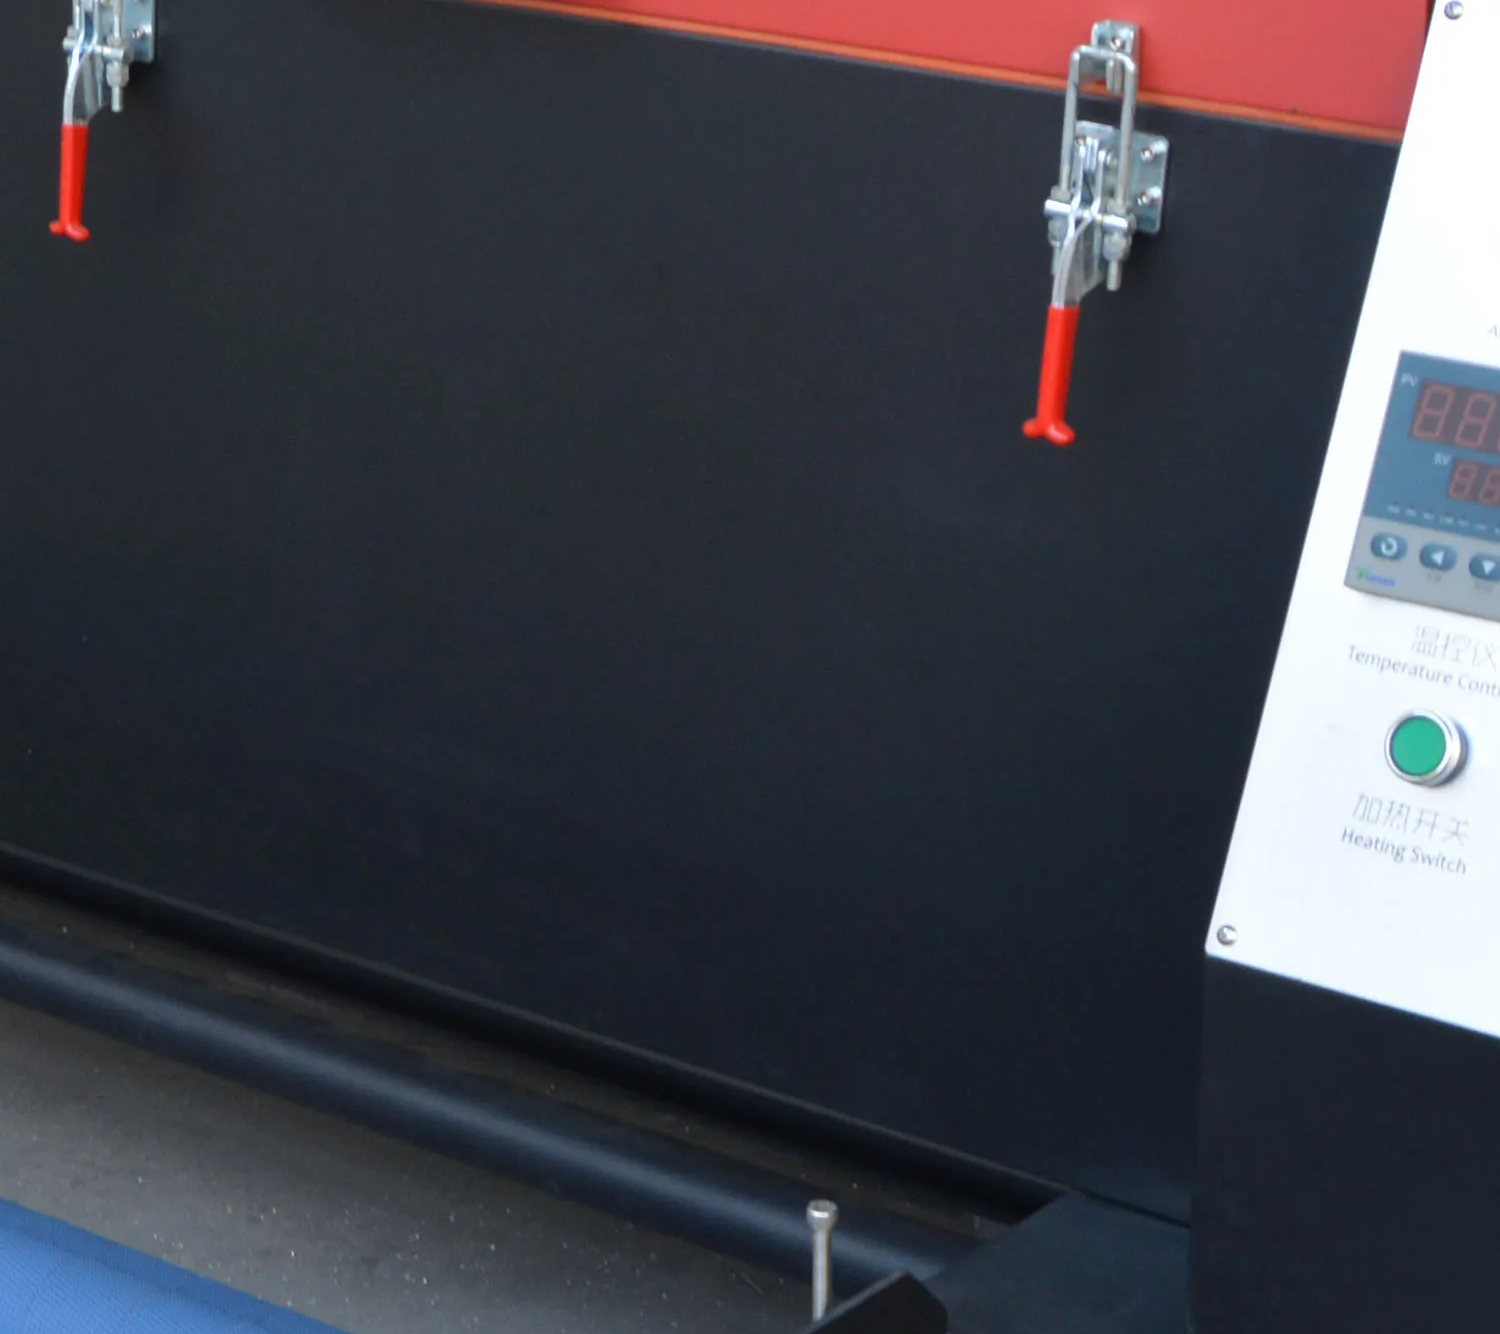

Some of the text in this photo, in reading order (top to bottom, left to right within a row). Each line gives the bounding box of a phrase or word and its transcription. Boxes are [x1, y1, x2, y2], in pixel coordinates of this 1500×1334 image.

[1400, 372, 1418, 388] PV
[1348, 644, 1454, 686] Temperature
[1341, 826, 1467, 876] Heating Switch
